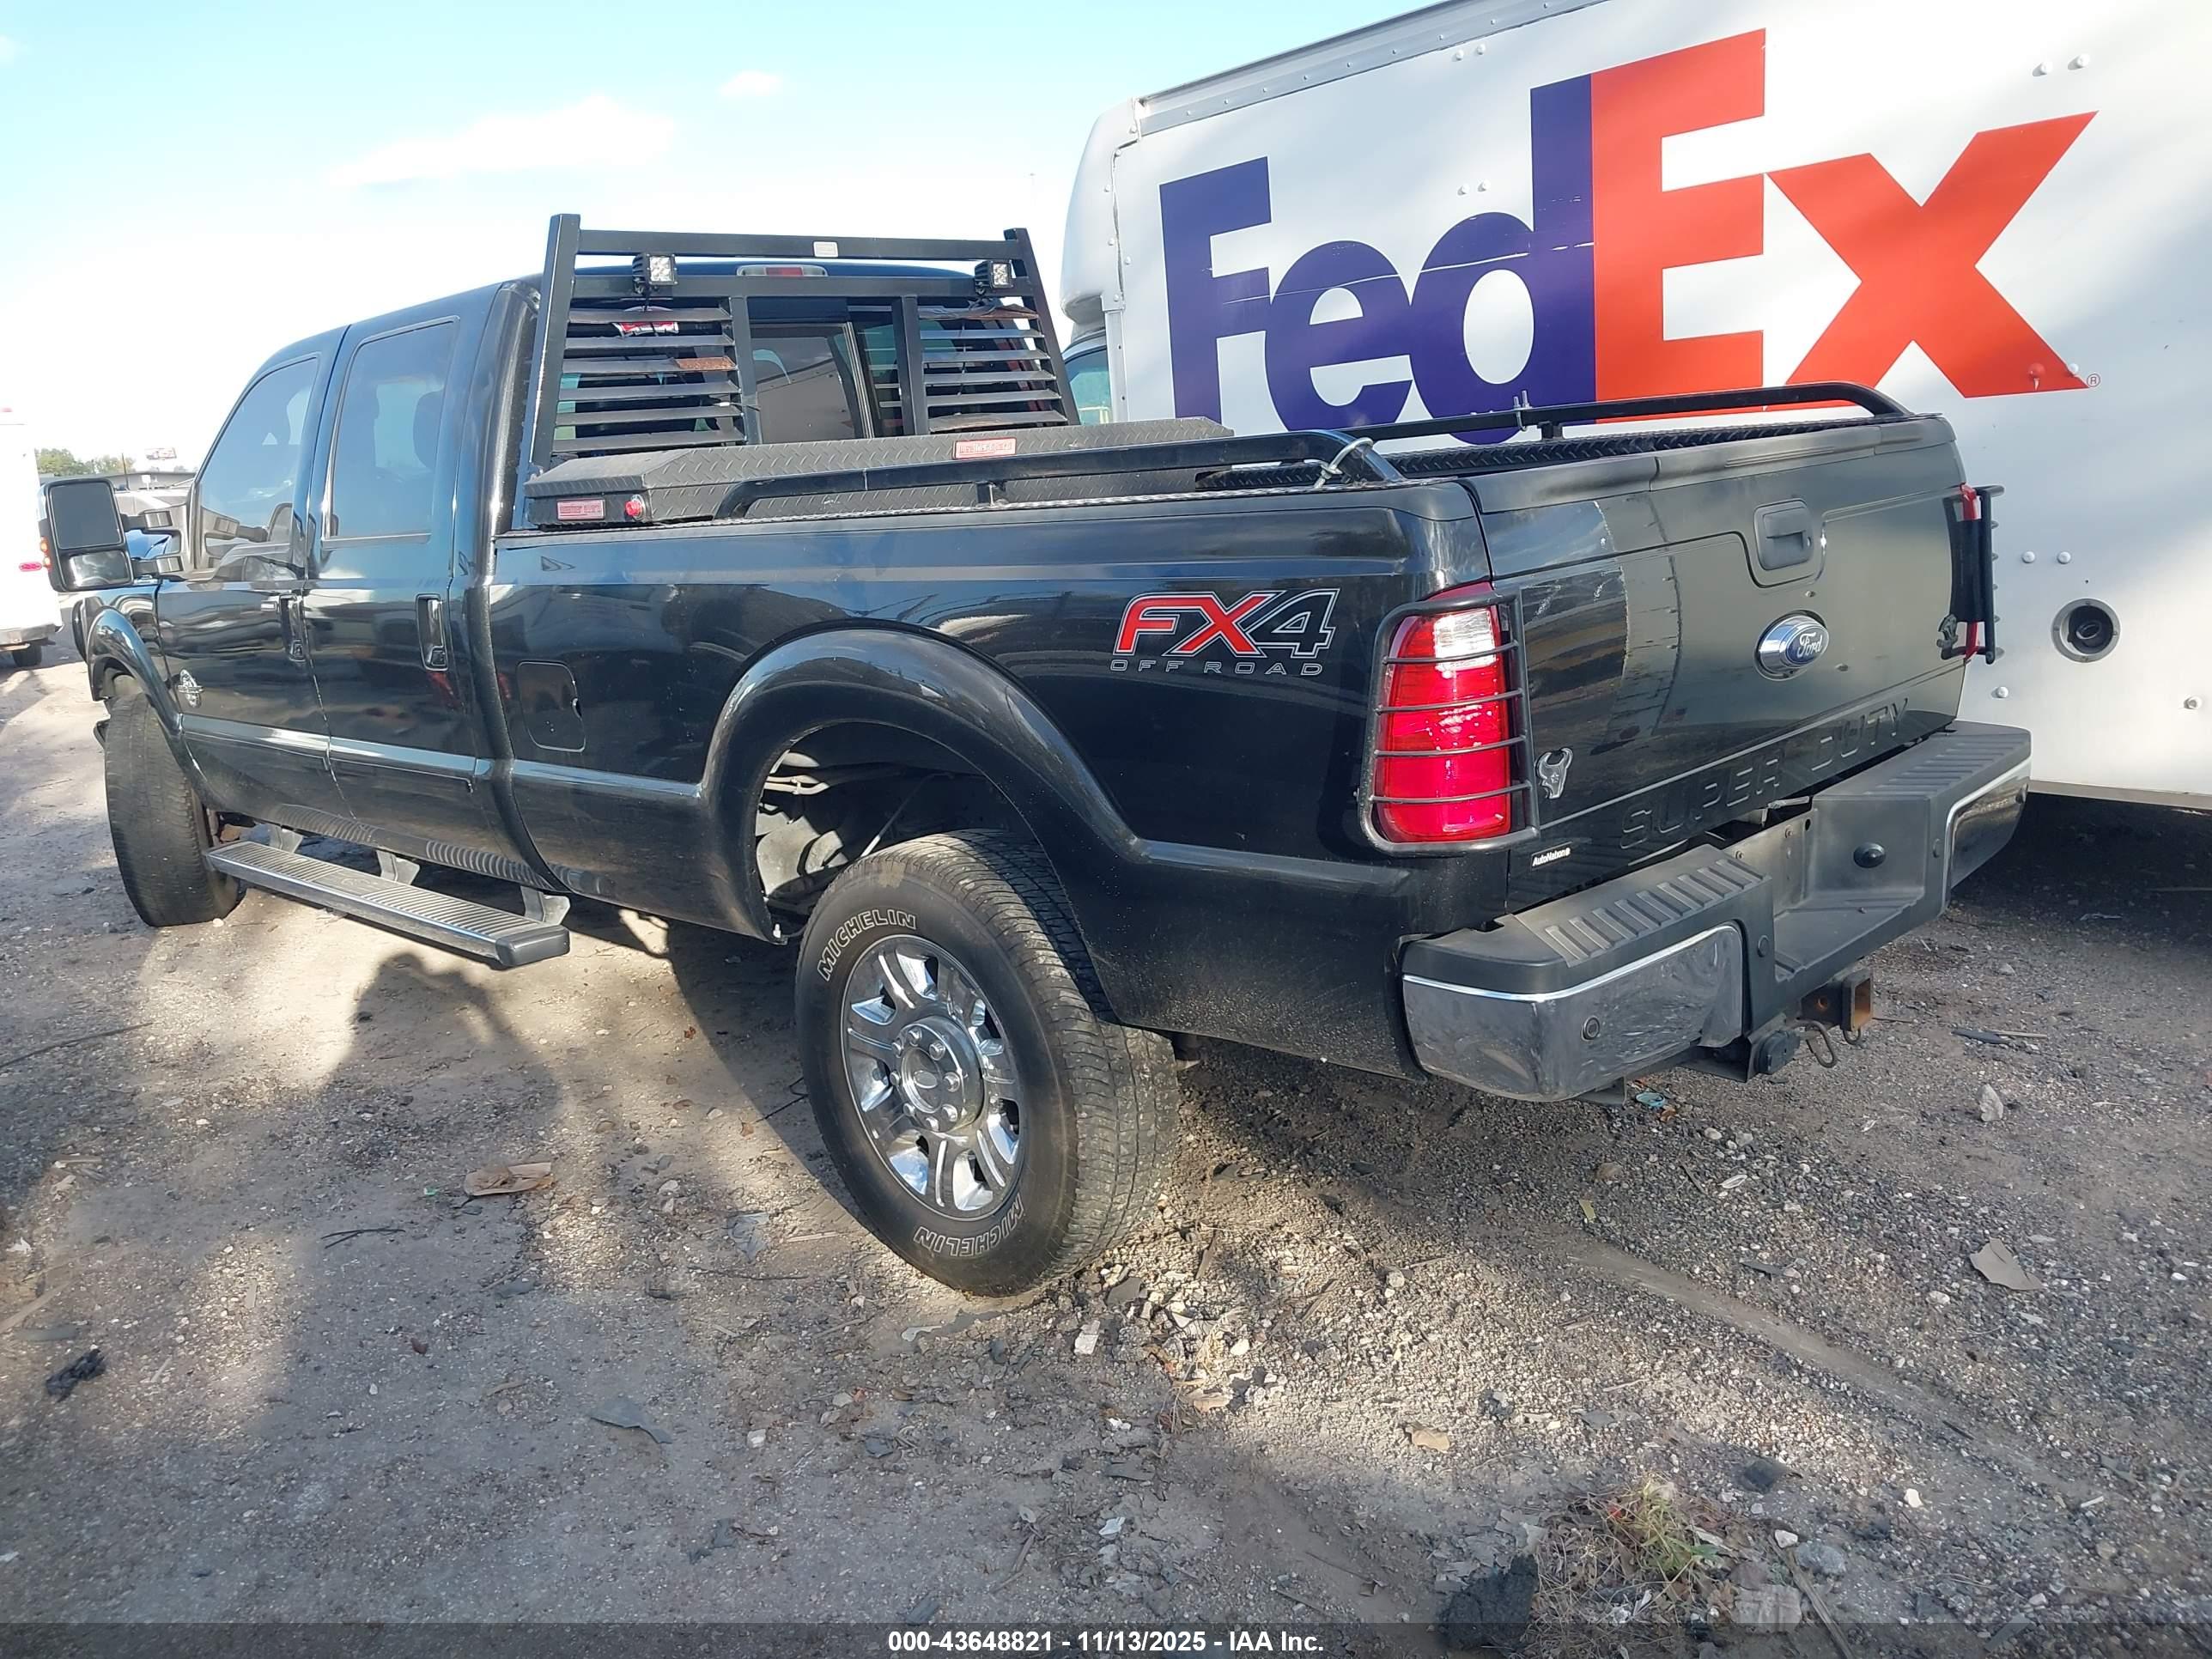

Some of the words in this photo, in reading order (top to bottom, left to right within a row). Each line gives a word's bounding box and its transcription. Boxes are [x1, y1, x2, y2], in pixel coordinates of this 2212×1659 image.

[1159, 28, 2098, 445] FedEx
[1112, 588, 1340, 659] FX4
[1796, 632, 1823, 658] Ford
[1110, 659, 1184, 672] OFF
[1203, 661, 1323, 676] ROAD
[1620, 745, 1784, 850] SUPER
[1810, 696, 1910, 773] DUTY
[817, 909, 917, 981] MICHELIN
[913, 1192, 1024, 1256] MICHELIN
